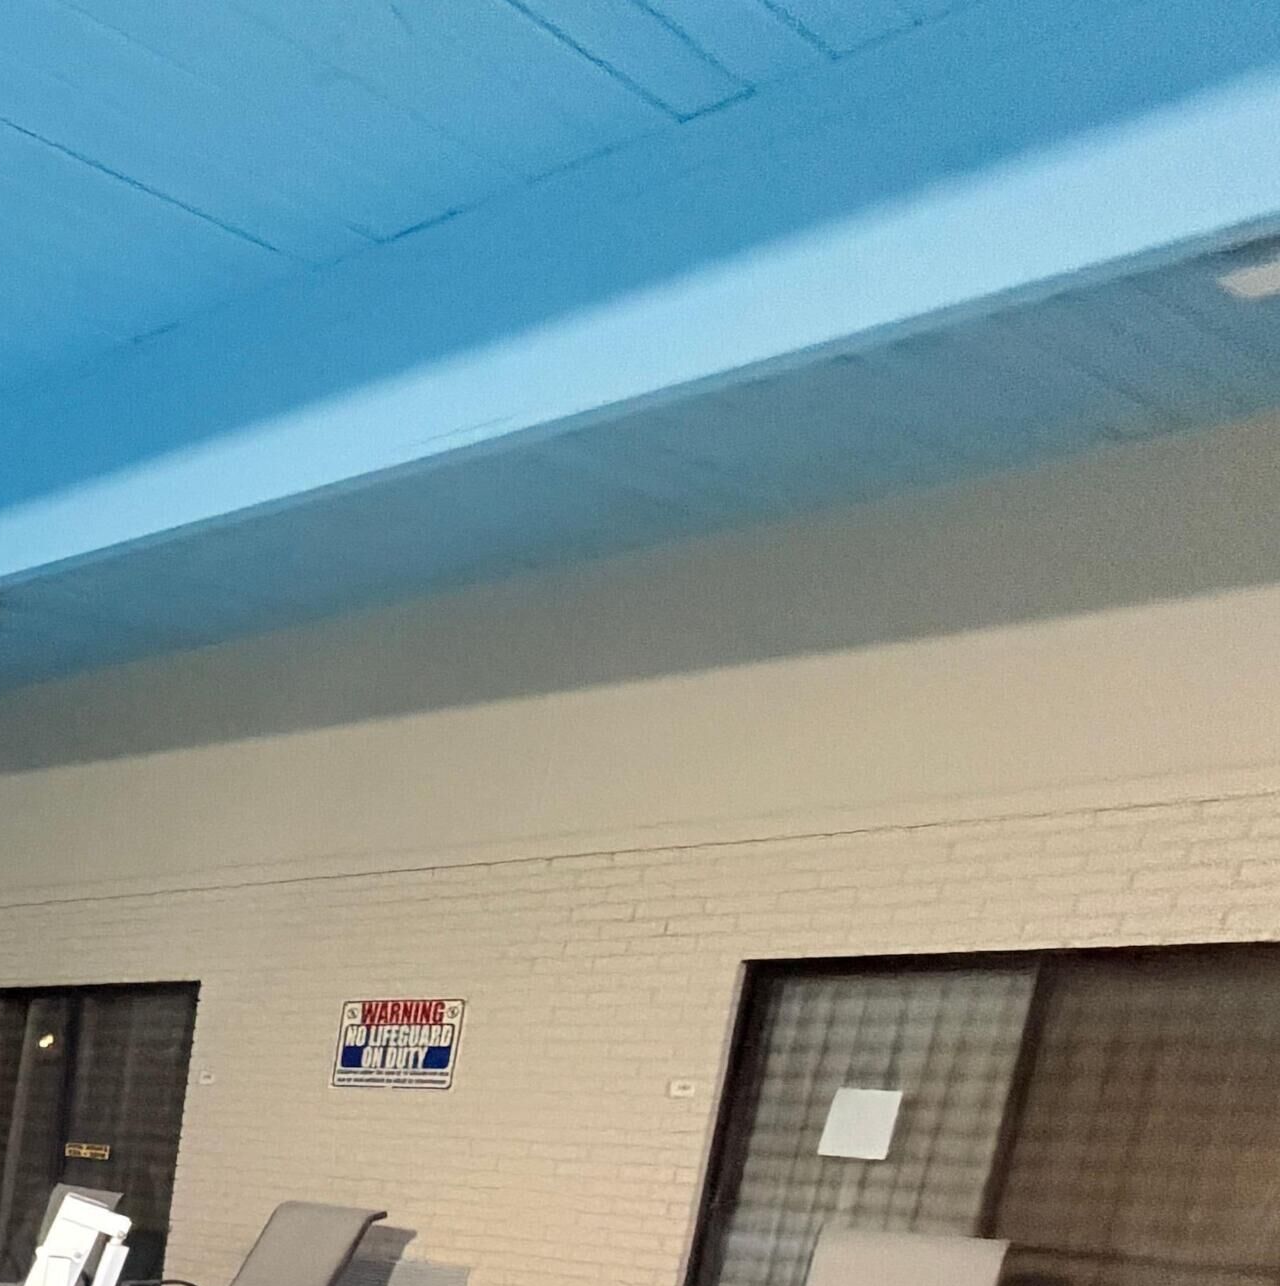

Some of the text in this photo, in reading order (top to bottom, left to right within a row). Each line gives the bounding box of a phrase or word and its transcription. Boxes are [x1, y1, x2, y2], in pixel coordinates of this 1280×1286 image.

[361, 1001, 446, 1024] WARNING
[345, 1025, 453, 1047] NO LIFEGUARD
[361, 1047, 428, 1069] ON DUTY
